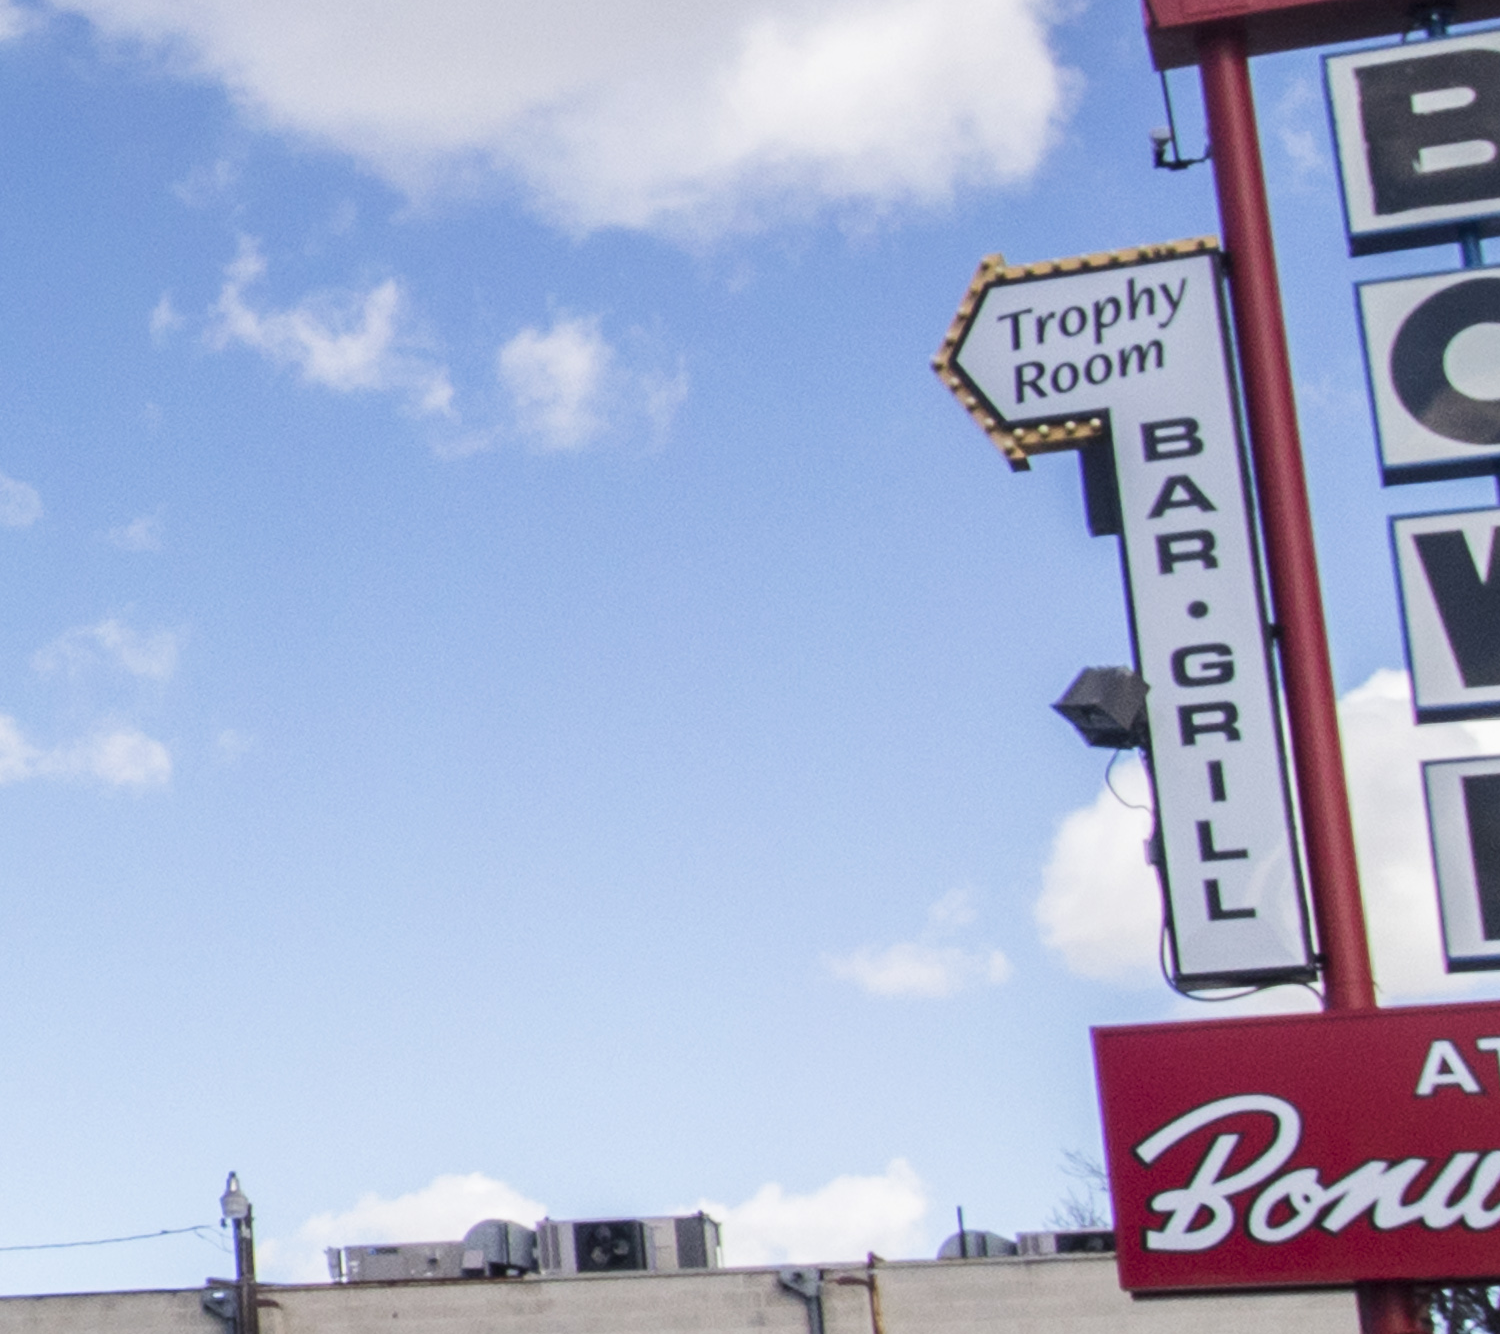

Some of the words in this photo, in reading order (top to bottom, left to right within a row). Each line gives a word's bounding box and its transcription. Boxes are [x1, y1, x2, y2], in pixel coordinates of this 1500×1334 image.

[997, 278, 1187, 354] Trophy
[1013, 338, 1165, 401] Room
[1142, 417, 1219, 573] BAR
[1171, 643, 1256, 921] GRILL
